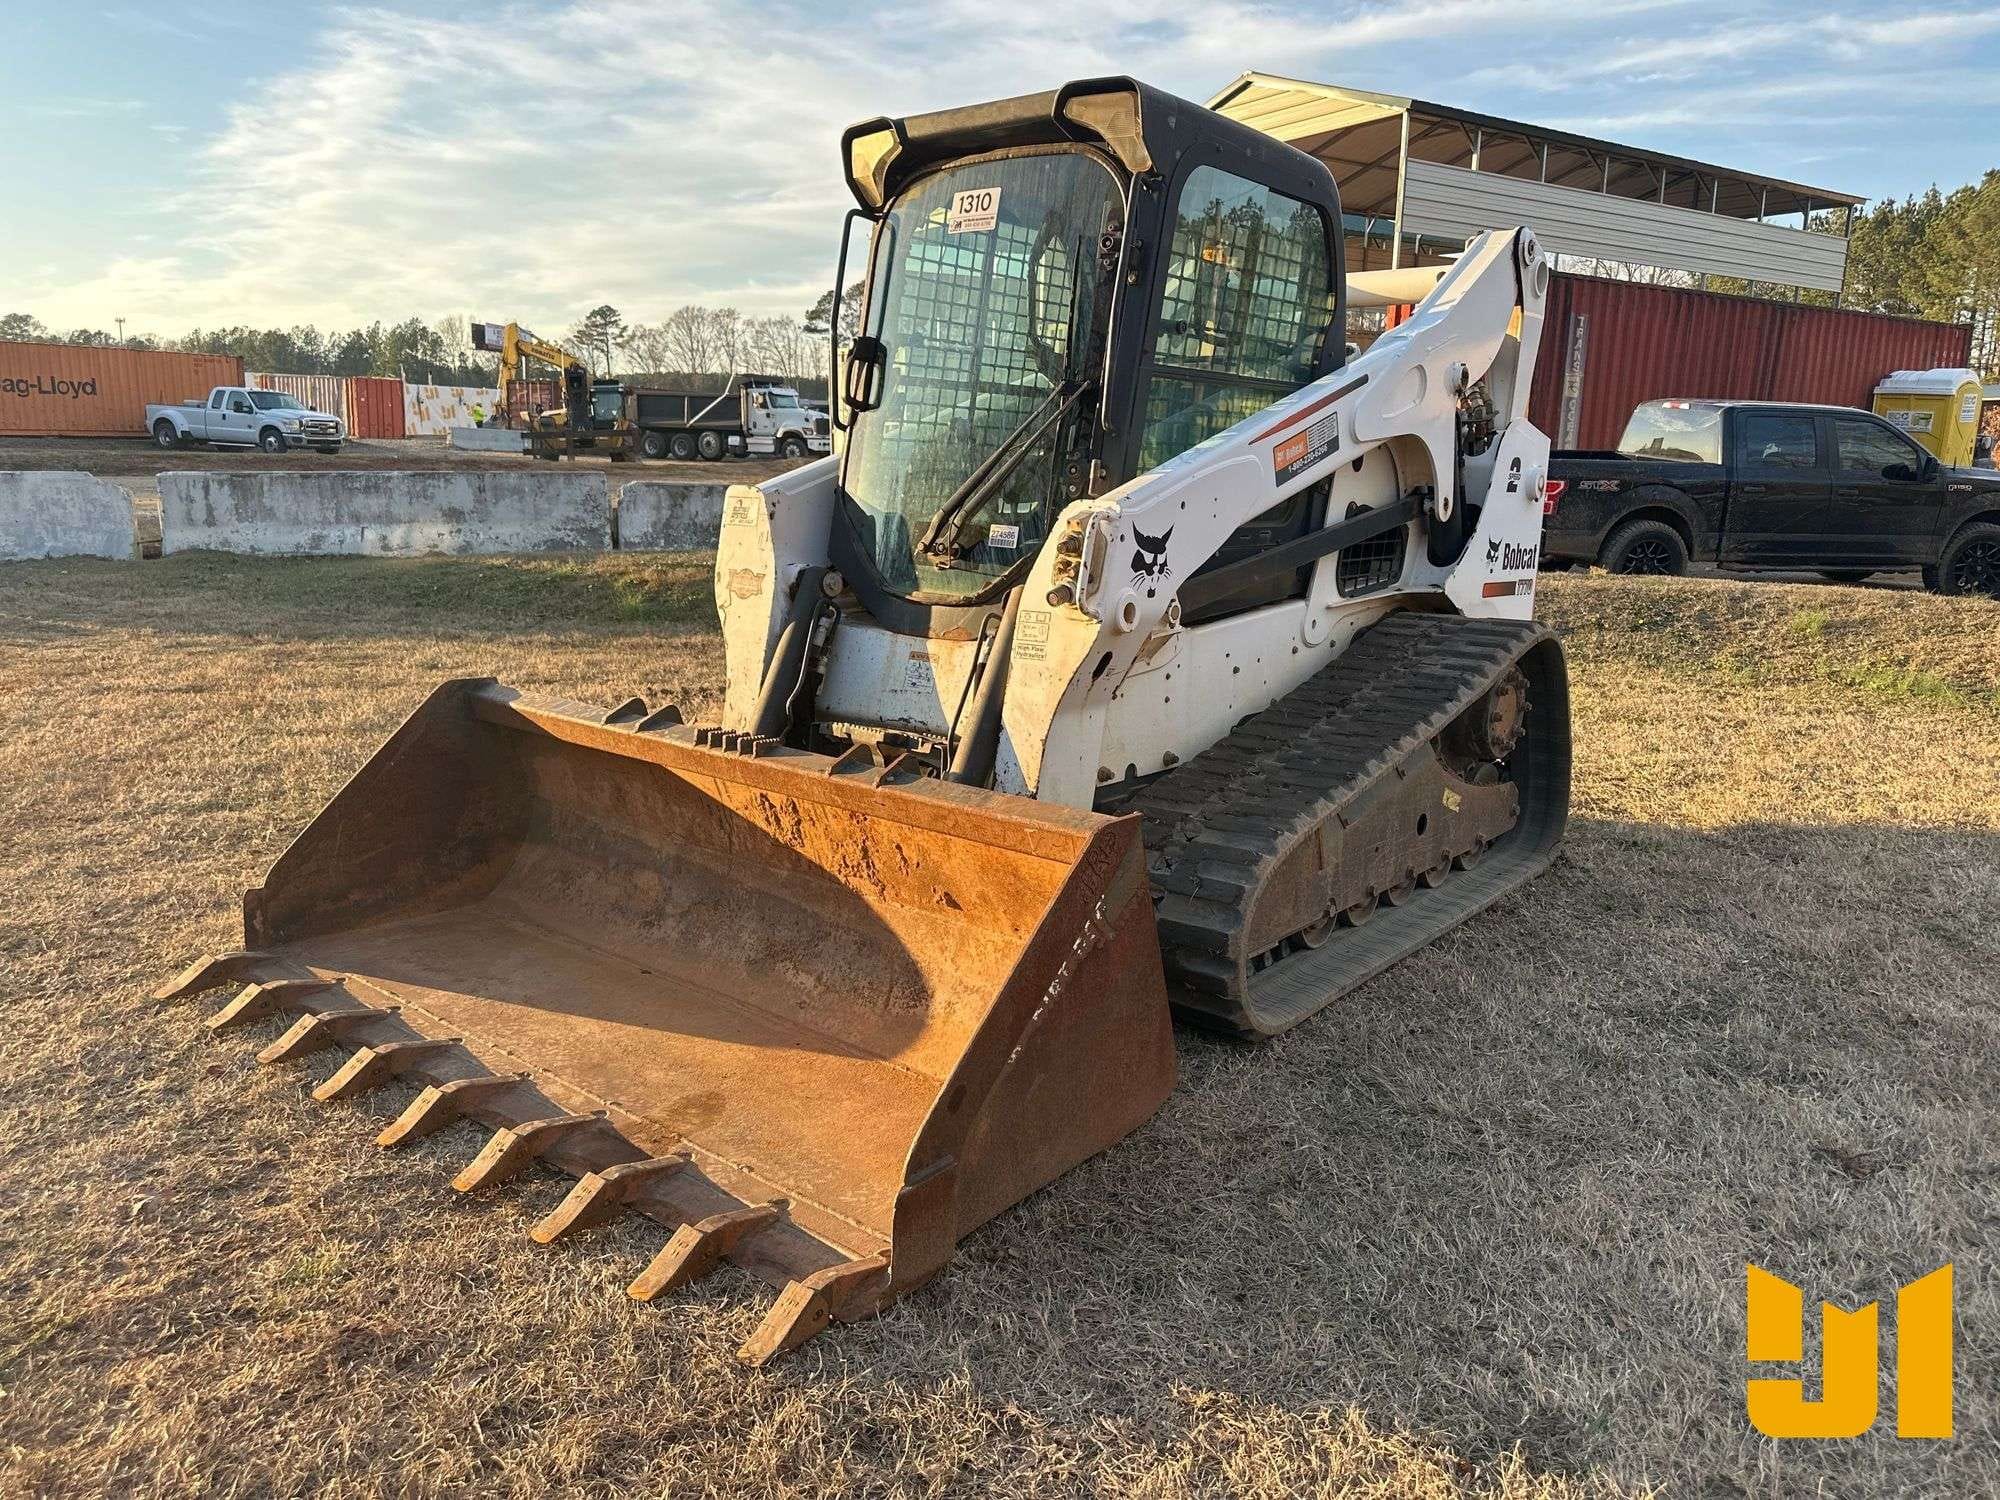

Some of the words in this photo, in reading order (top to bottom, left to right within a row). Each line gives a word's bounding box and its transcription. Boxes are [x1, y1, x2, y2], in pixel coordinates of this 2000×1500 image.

[959, 192, 992, 214] 1310
[0, 375, 97, 399] ag-Lloyd
[1502, 543, 1537, 570] Bobcat
